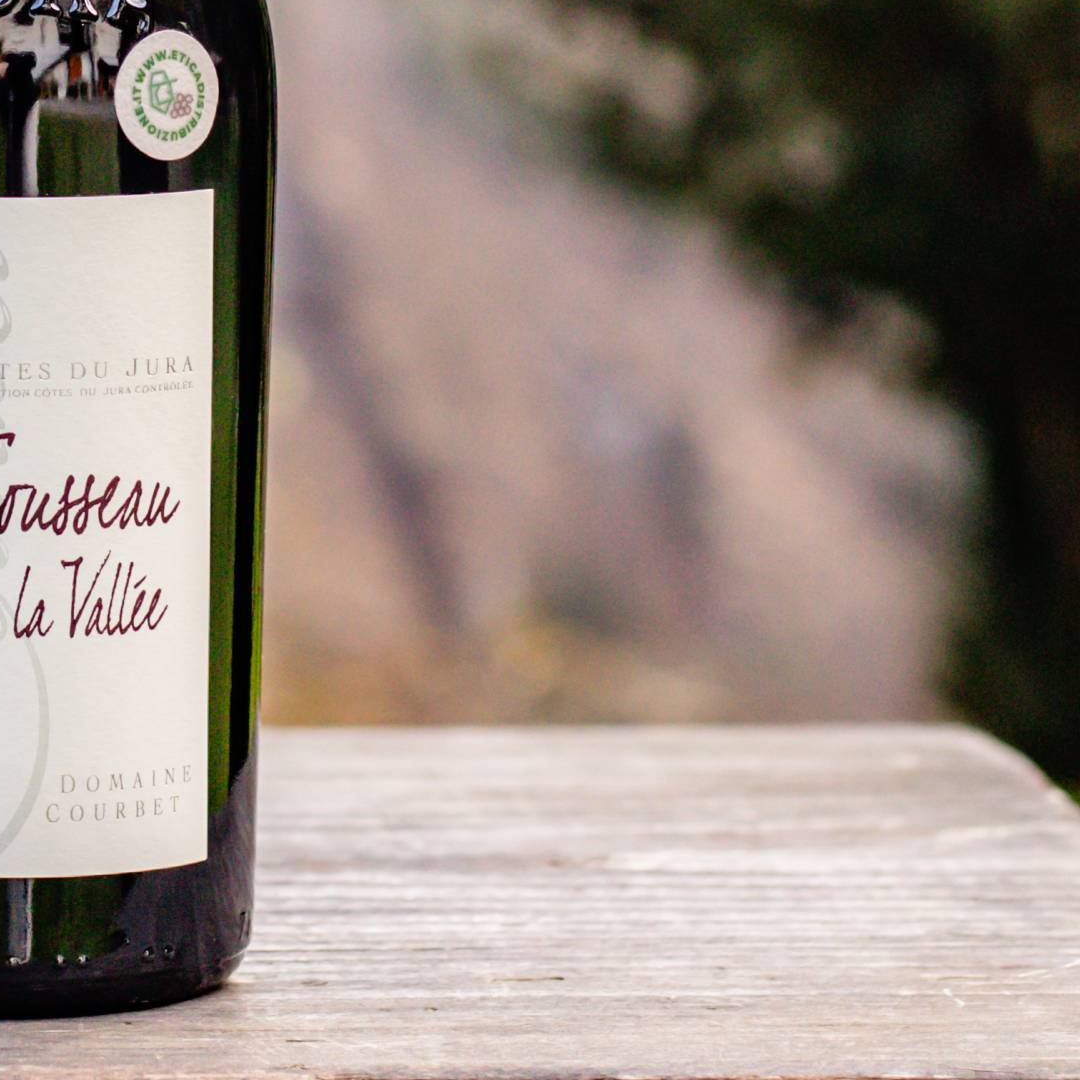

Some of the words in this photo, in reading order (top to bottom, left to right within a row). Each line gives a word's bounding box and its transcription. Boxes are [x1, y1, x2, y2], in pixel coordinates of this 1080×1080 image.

[132, 49, 206, 142] WWW.ETICADISTRIBUZIONE.IT
[70, 361, 108, 380] DU
[125, 355, 194, 377] JURA
[103, 384, 132, 396] JURA
[13, 565, 55, 639] la
[60, 549, 169, 639] Vallée
[60, 764, 193, 794] DOMAINE
[45, 795, 181, 823] COURBET
